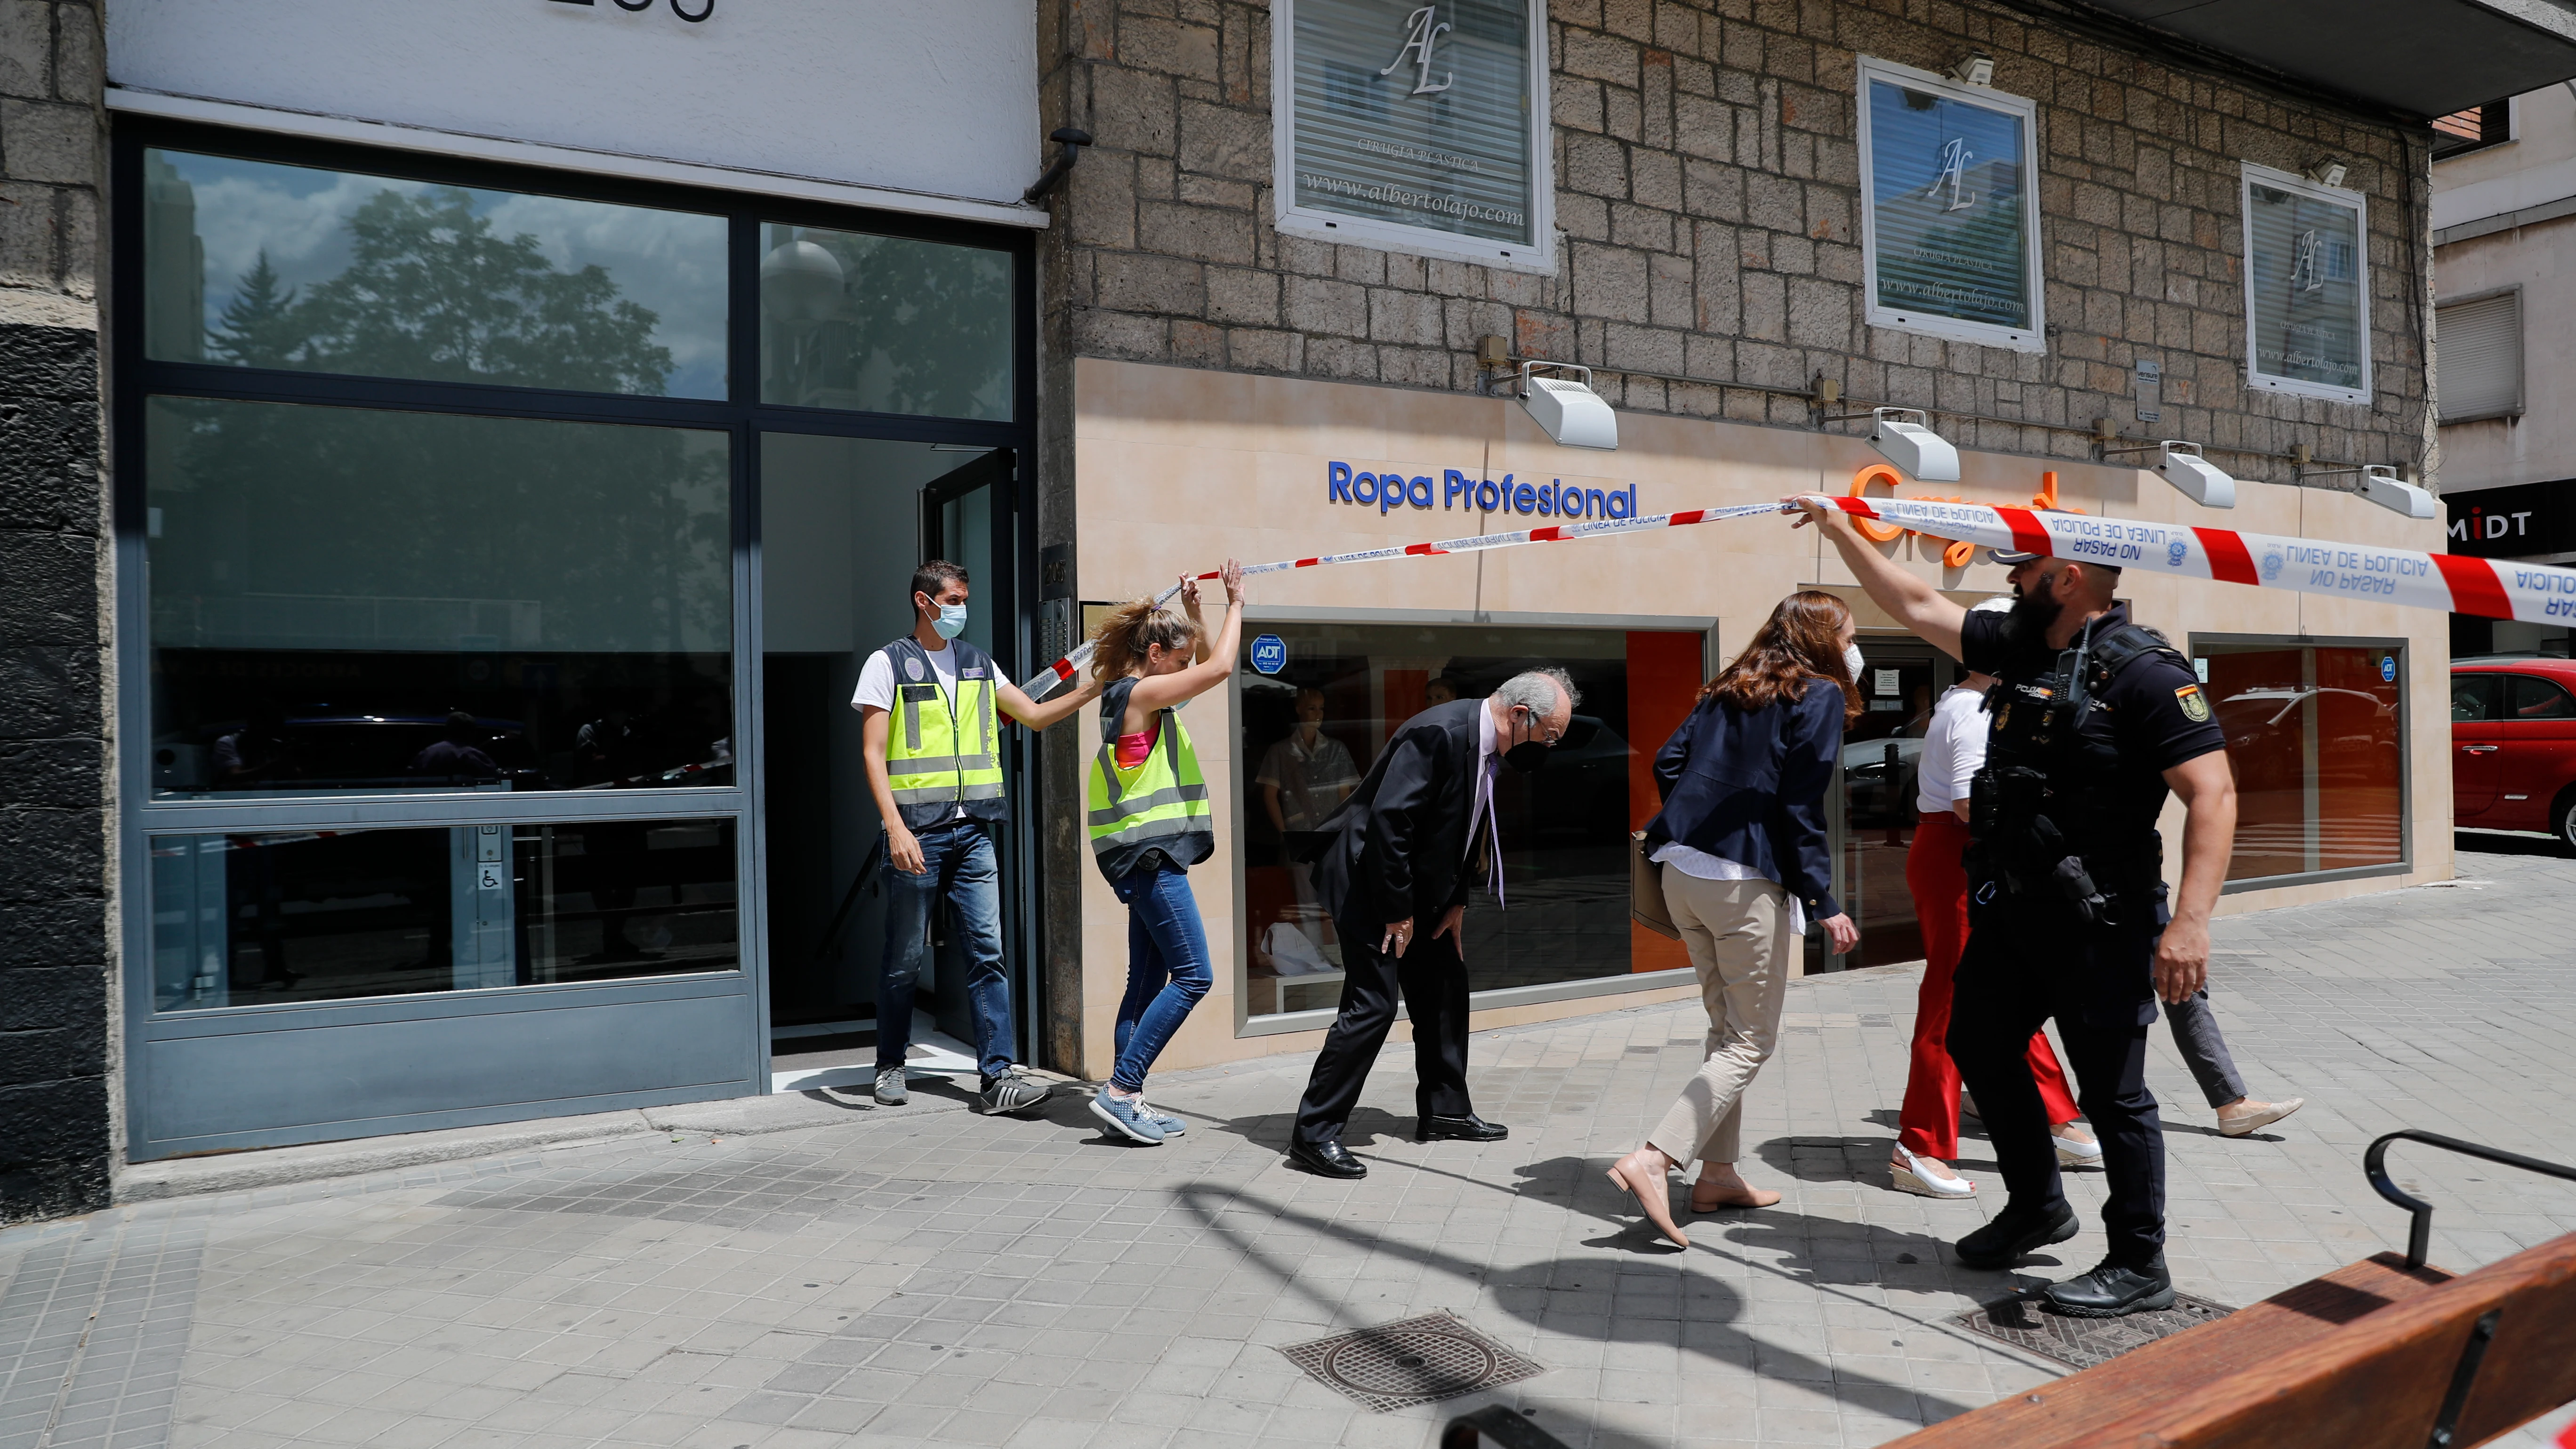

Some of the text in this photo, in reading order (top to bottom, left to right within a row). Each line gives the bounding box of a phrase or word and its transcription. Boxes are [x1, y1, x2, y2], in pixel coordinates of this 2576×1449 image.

[1303, 174, 1525, 226] www.albertolajo.com
[1880, 282, 2025, 314] www.albertolajo.com
[2258, 348, 2358, 375] www.albertolajo.com
[1329, 461, 1636, 518] Ropa Profesional
[2050, 518, 2166, 545] LINEA DE POLICIA
[2073, 538, 2141, 560] NO PASAR
[1044, 559, 1066, 586] 205
[1257, 645, 1280, 659] ADT
